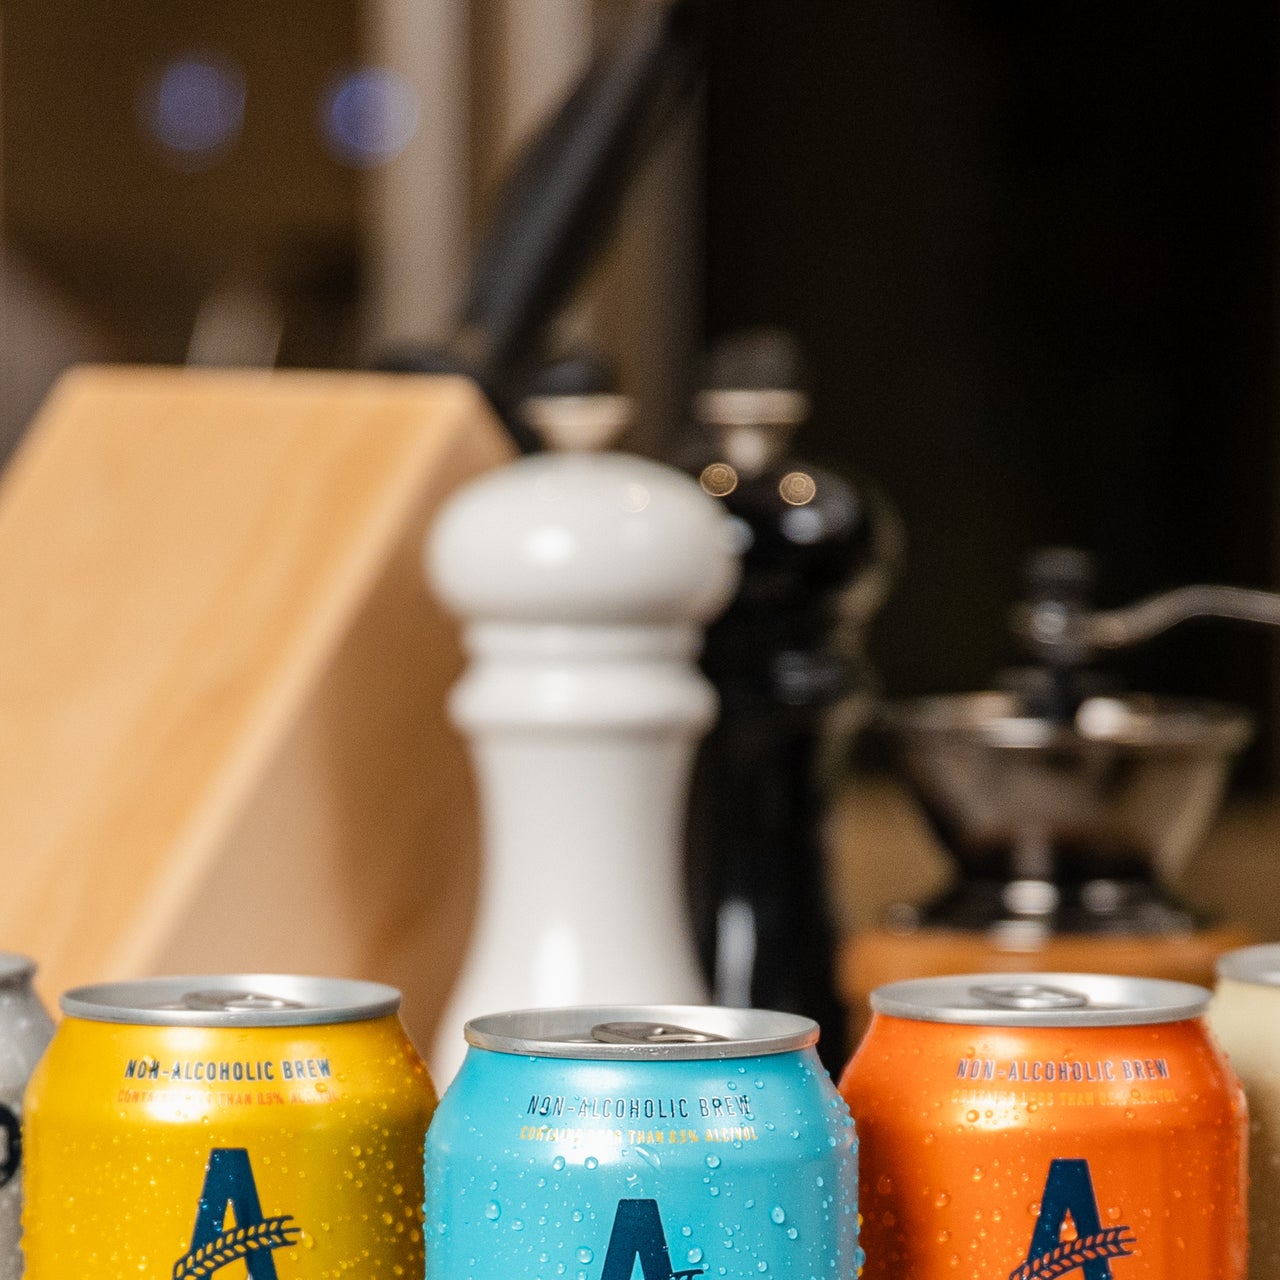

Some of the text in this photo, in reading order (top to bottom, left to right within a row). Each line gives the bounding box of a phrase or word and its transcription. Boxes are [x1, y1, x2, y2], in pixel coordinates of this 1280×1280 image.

[124, 1058, 332, 1082] NON-ALCOHOLIC BREW
[957, 1058, 1170, 1082] NON-ALCOHOLIC BREW
[527, 1094, 751, 1118] NON-ALCOHOLIC BREW
[628, 1128, 664, 1145] THAN
[669, 1127, 700, 1144] 0.5%
